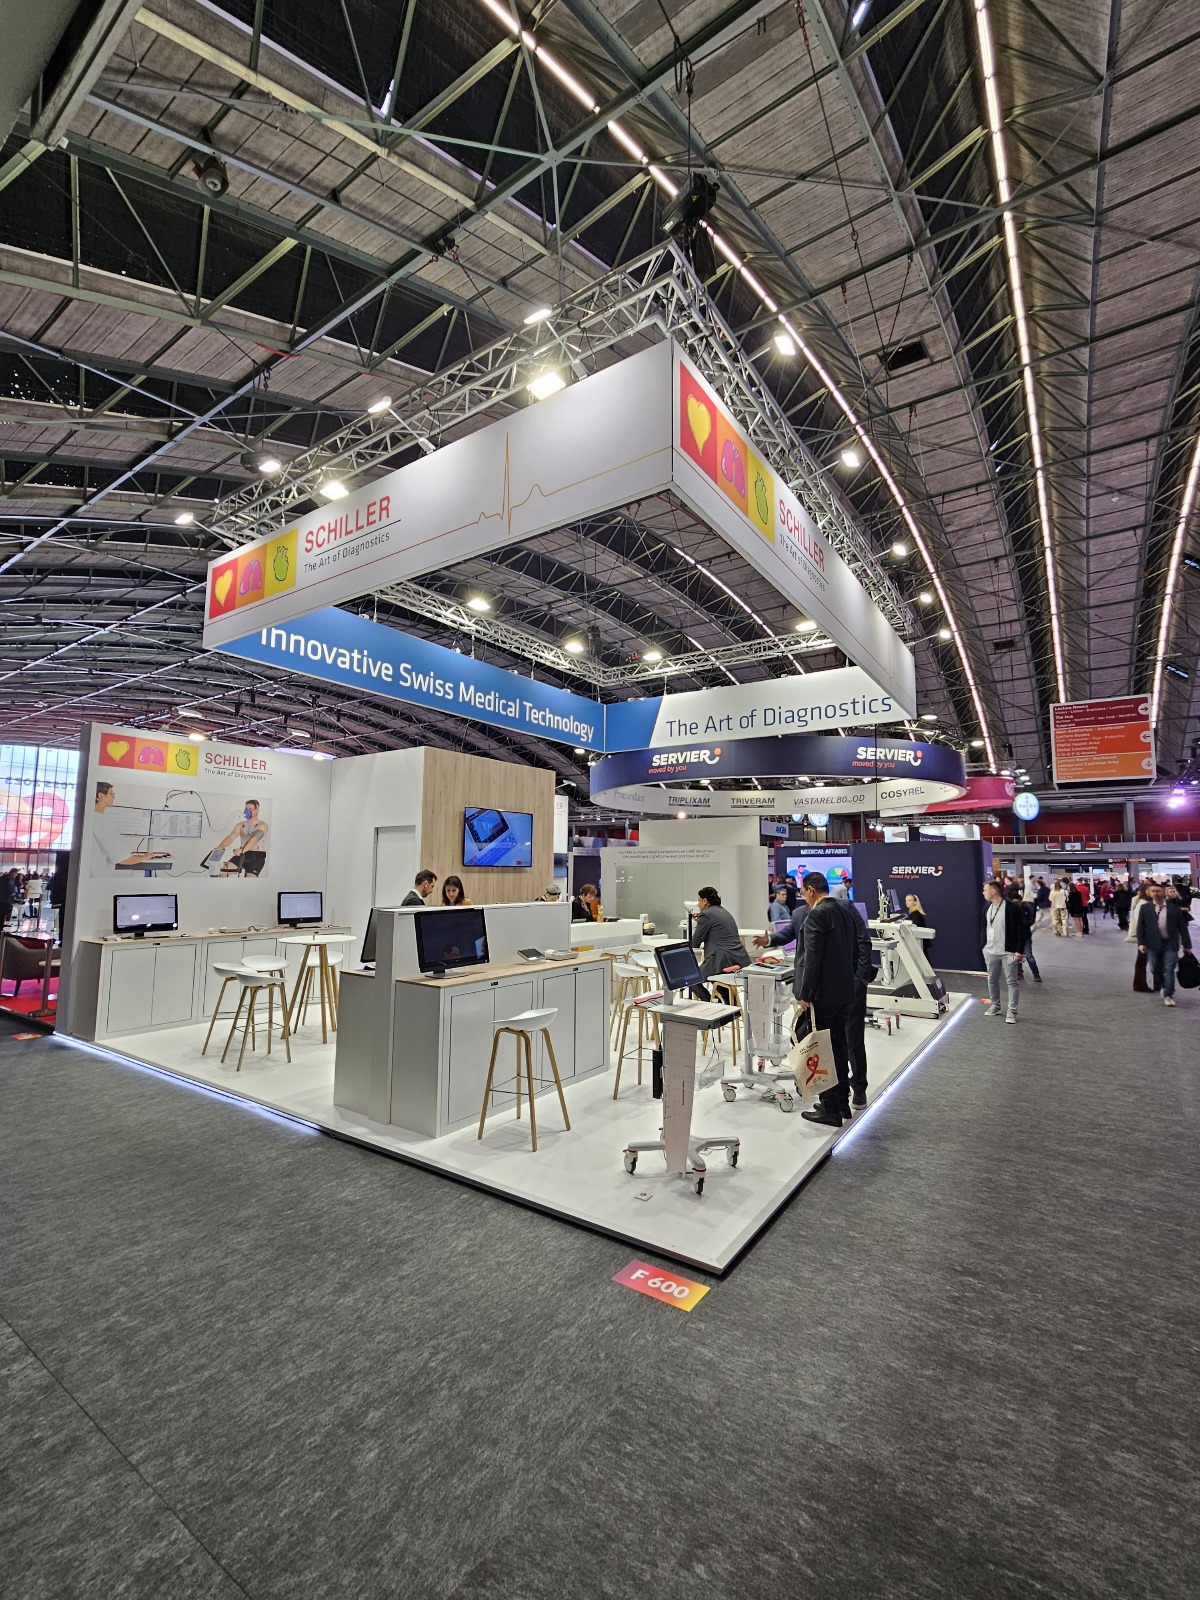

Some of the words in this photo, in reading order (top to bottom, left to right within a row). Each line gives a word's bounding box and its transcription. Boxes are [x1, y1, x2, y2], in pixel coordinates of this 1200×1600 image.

[305, 495, 391, 553] SCHILLER
[779, 498, 825, 573] SCHILLER
[303, 562, 317, 574] The
[318, 556, 331, 568] Art
[332, 550, 341, 562] of
[342, 532, 390, 559] Diagnostics
[261, 627, 394, 683] Innovative
[399, 662, 454, 700] Swiss
[459, 681, 520, 719] Medical
[523, 701, 595, 743] Technology
[665, 719, 699, 738] The
[704, 714, 733, 734] Art
[739, 708, 757, 729] of
[763, 695, 892, 727] Diagnostics
[205, 752, 267, 771] SCHILLER
[652, 749, 720, 767] SERVIER
[856, 747, 922, 767] SERVIER
[234, 772, 267, 781] Diagnostics
[648, 766, 666, 774] moved
[667, 765, 675, 774] by
[675, 765, 687, 773] you
[668, 796, 710, 804] TRIPLIXAM
[793, 796, 835, 805] VASTAREL
[880, 786, 925, 800] COSYREL
[892, 866, 943, 876] SERVIER
[630, 1269, 650, 1280] F
[647, 1277, 690, 1298] 600
